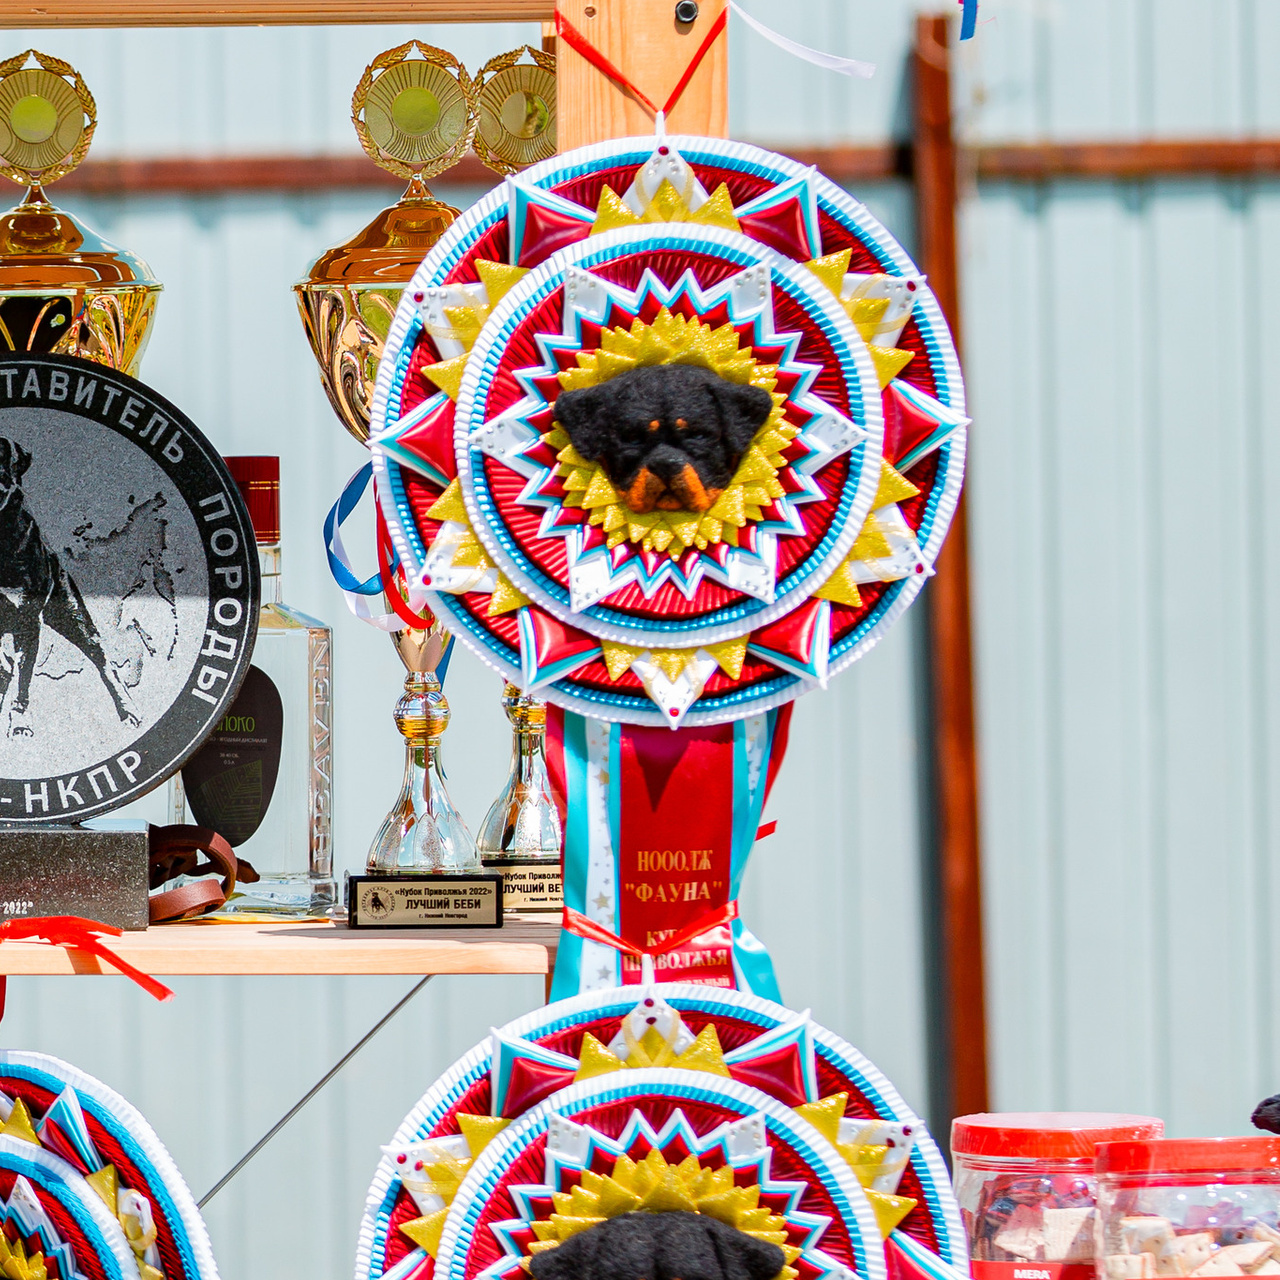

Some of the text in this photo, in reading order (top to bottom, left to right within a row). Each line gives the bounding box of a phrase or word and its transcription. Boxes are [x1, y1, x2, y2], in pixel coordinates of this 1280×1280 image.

[191, 490, 244, 706] ПОРОДЫ
[312, 636, 331, 864] HEAVEN
[637, 849, 714, 872] НОООЛЖ
[395, 887, 493, 897] «Кубок Приволжья 2022»
[503, 882, 544, 893] ЛУЧШИЙ
[625, 880, 723, 903] "ФАУНА"
[2, 901, 34, 915] 2022"
[405, 897, 481, 910] ЛУЧШИЙ БЕБИ
[1014, 1269, 1050, 1280] MERA
